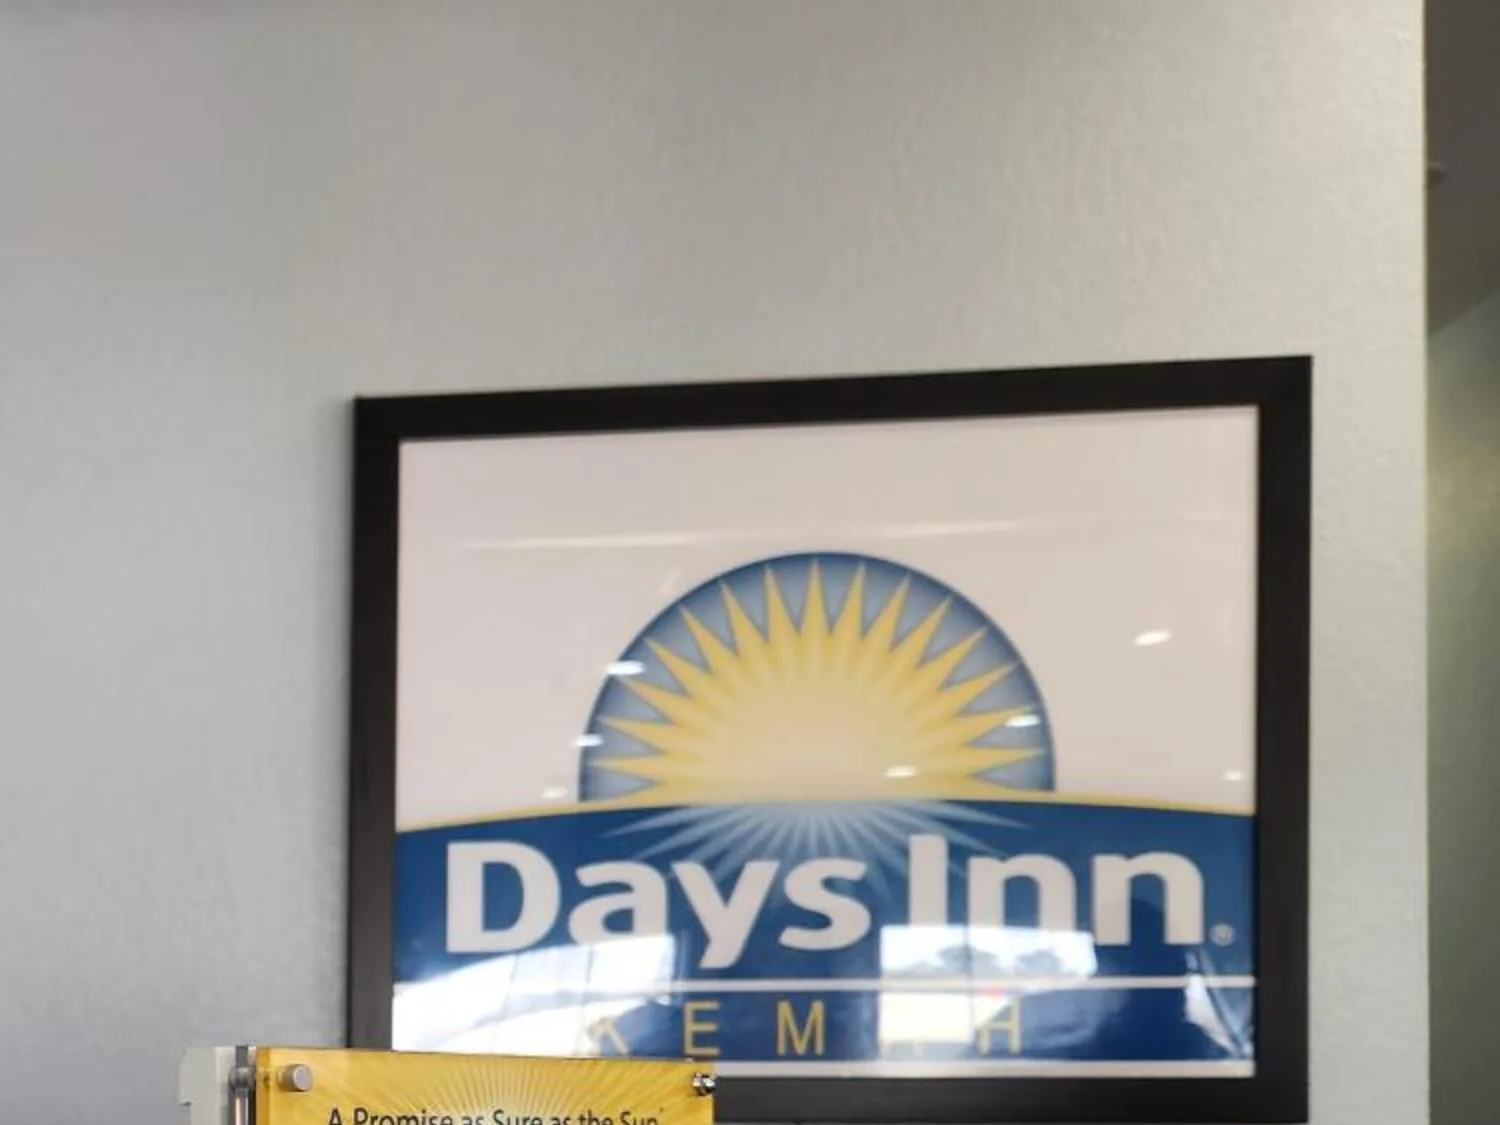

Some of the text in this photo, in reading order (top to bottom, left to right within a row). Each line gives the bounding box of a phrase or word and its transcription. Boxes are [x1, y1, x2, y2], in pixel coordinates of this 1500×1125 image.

[447, 833, 1204, 969] Days Inn
[582, 998, 1022, 1057] KEMH
